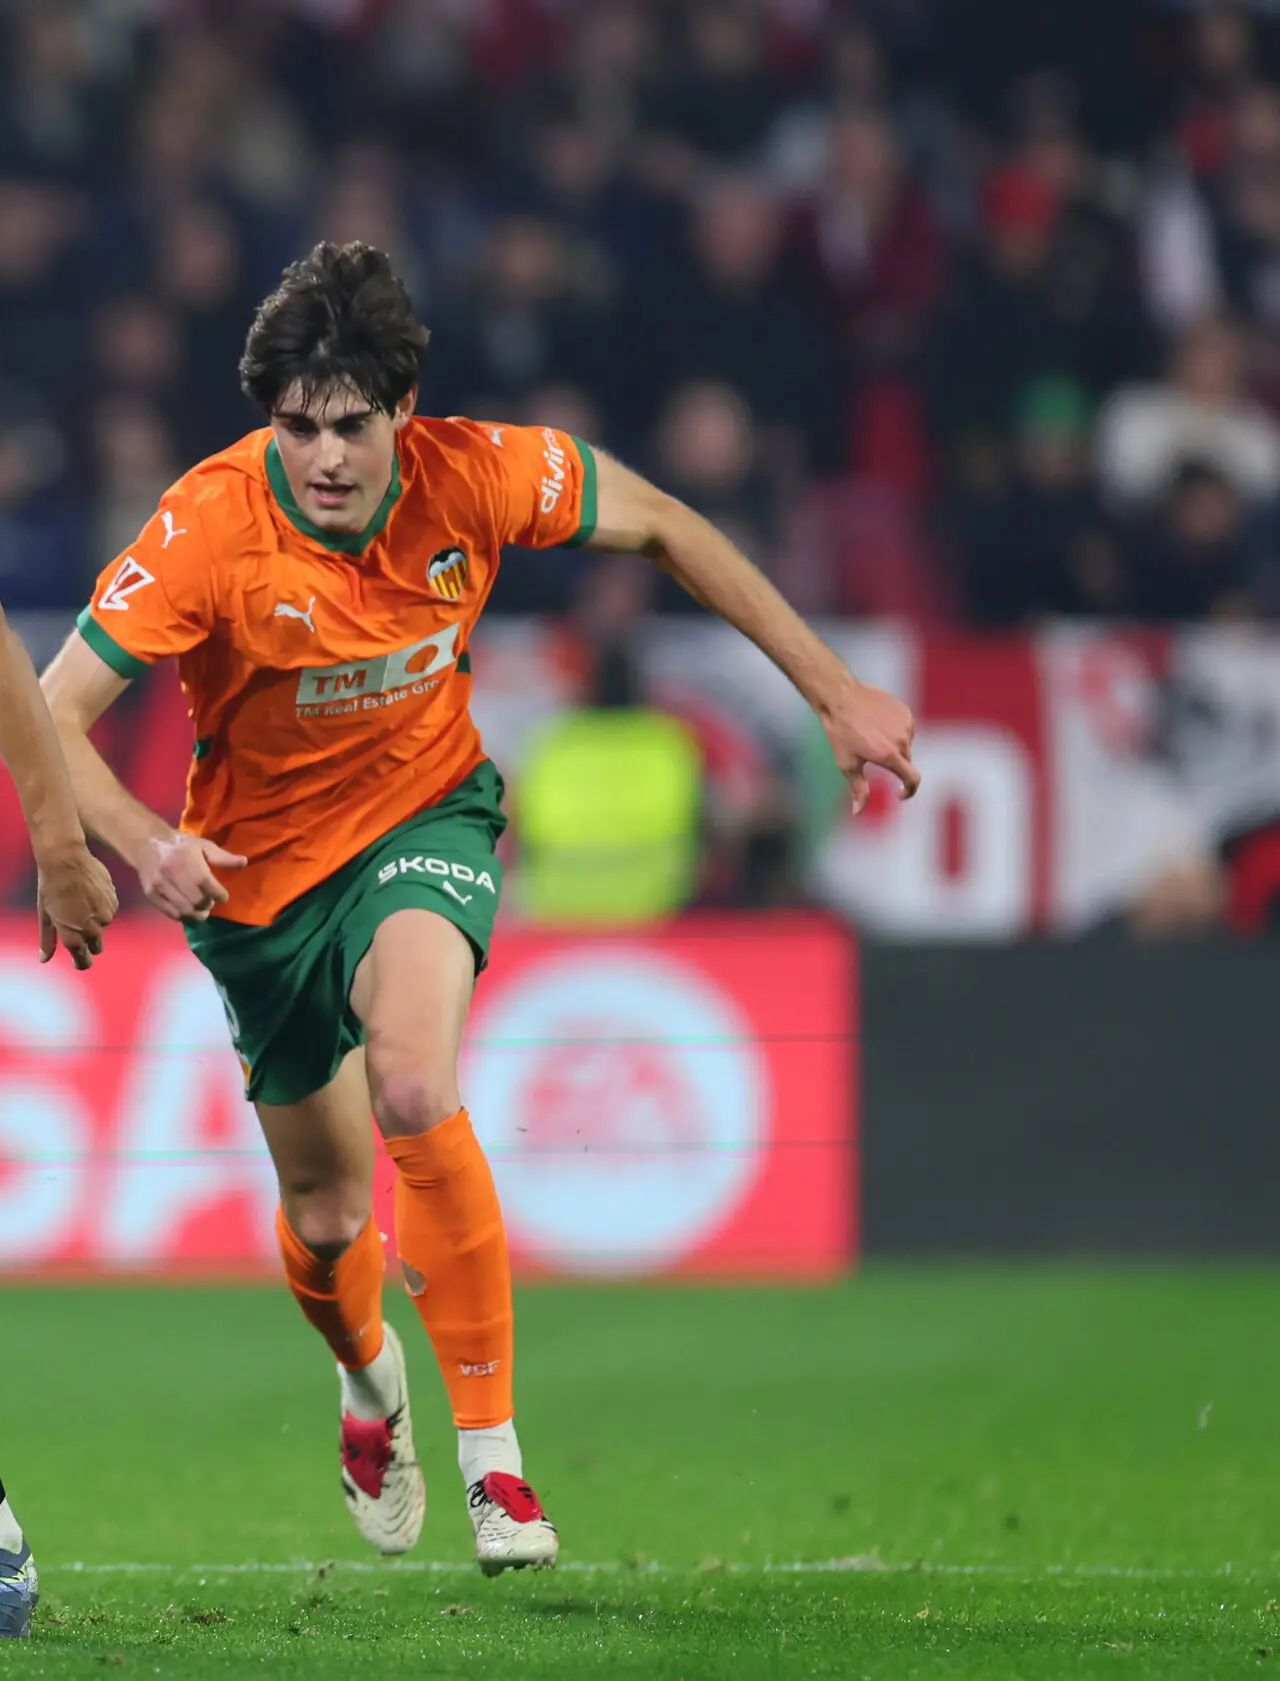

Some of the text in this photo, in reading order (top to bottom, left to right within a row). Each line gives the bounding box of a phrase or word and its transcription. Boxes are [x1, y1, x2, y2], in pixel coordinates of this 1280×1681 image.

[312, 669, 368, 696] TM
[324, 699, 358, 716] Real
[363, 688, 408, 710] Estate
